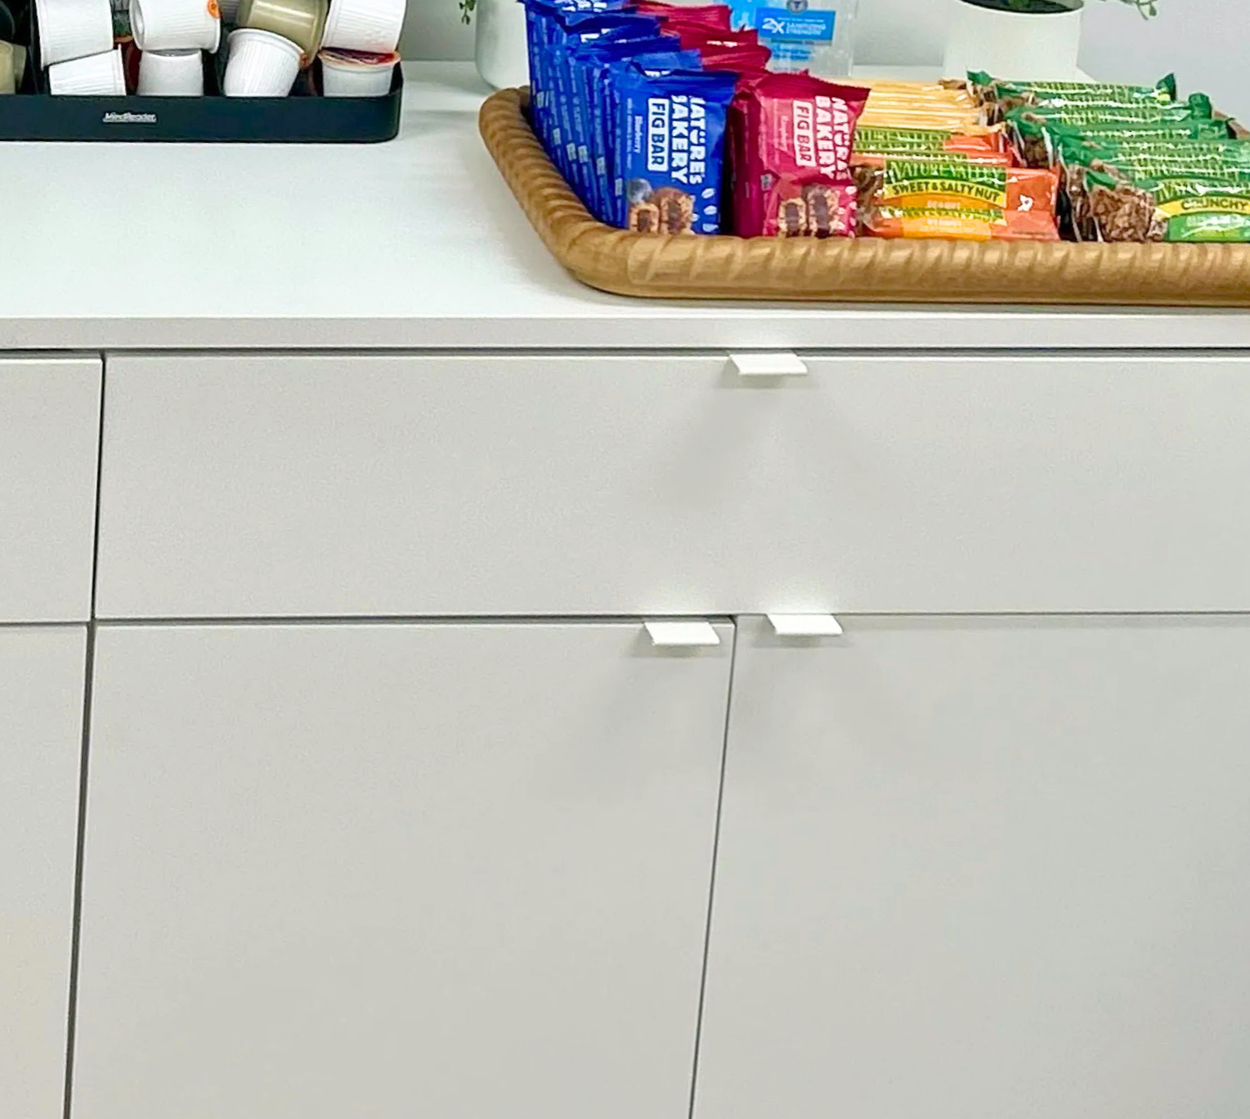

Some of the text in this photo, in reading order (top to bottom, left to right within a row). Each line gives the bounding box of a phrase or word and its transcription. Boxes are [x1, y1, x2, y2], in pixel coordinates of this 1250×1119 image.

[761, 17, 786, 34] 2X
[651, 103, 666, 165] FIG BAR
[796, 106, 812, 161] FIG BAR
[815, 95, 836, 179] BAKERY
[890, 161, 1002, 185] NATURE VALLEY
[892, 181, 1001, 203] SWEET & SALTY NUT
